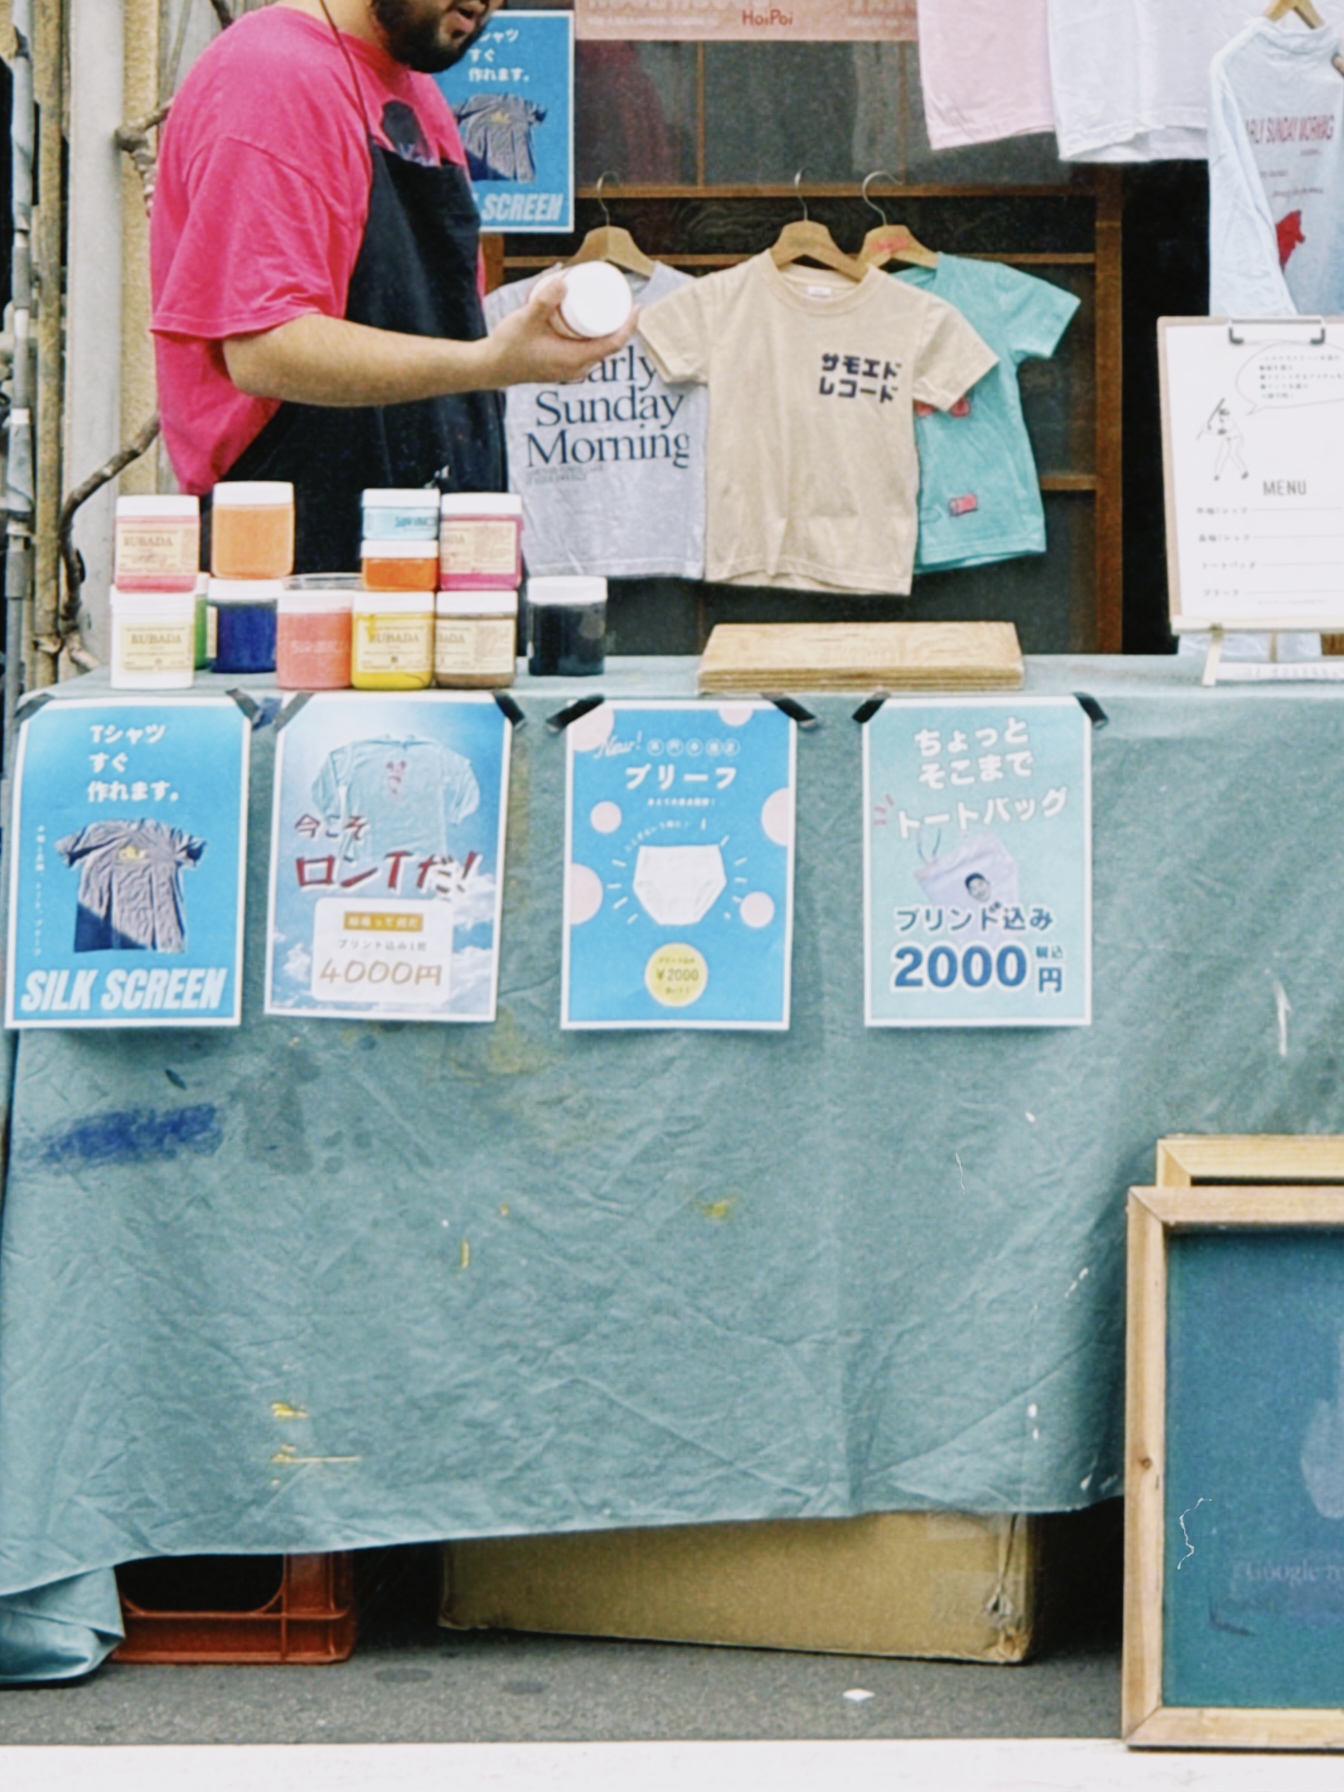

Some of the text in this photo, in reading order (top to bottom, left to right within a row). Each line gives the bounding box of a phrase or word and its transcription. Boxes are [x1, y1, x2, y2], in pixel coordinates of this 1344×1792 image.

[741, 9, 794, 26] HoiPoi
[469, 48, 496, 63] すぐ
[468, 67, 530, 83] 作れます。
[482, 193, 564, 222] SCREEN
[821, 352, 903, 381] サモエド
[818, 375, 899, 404] レコード
[535, 384, 685, 430] Sunday
[525, 423, 691, 470] Morning
[1263, 479, 1307, 496] MENU
[89, 723, 166, 744] Tシャツ
[914, 716, 1029, 757] ちょっと
[88, 752, 129, 773] すぐ
[918, 749, 1035, 790] そこまで
[625, 763, 738, 791] ブリーフ
[87, 780, 180, 803] 作れます。
[897, 785, 1069, 840] トートバッグ
[294, 814, 368, 842] 今こそ
[896, 907, 1054, 932] プリント込み
[319, 959, 443, 987] 4000円
[893, 944, 1028, 989] 2000
[1037, 966, 1063, 994] 円
[21, 967, 228, 1012] SILK SCREEN
